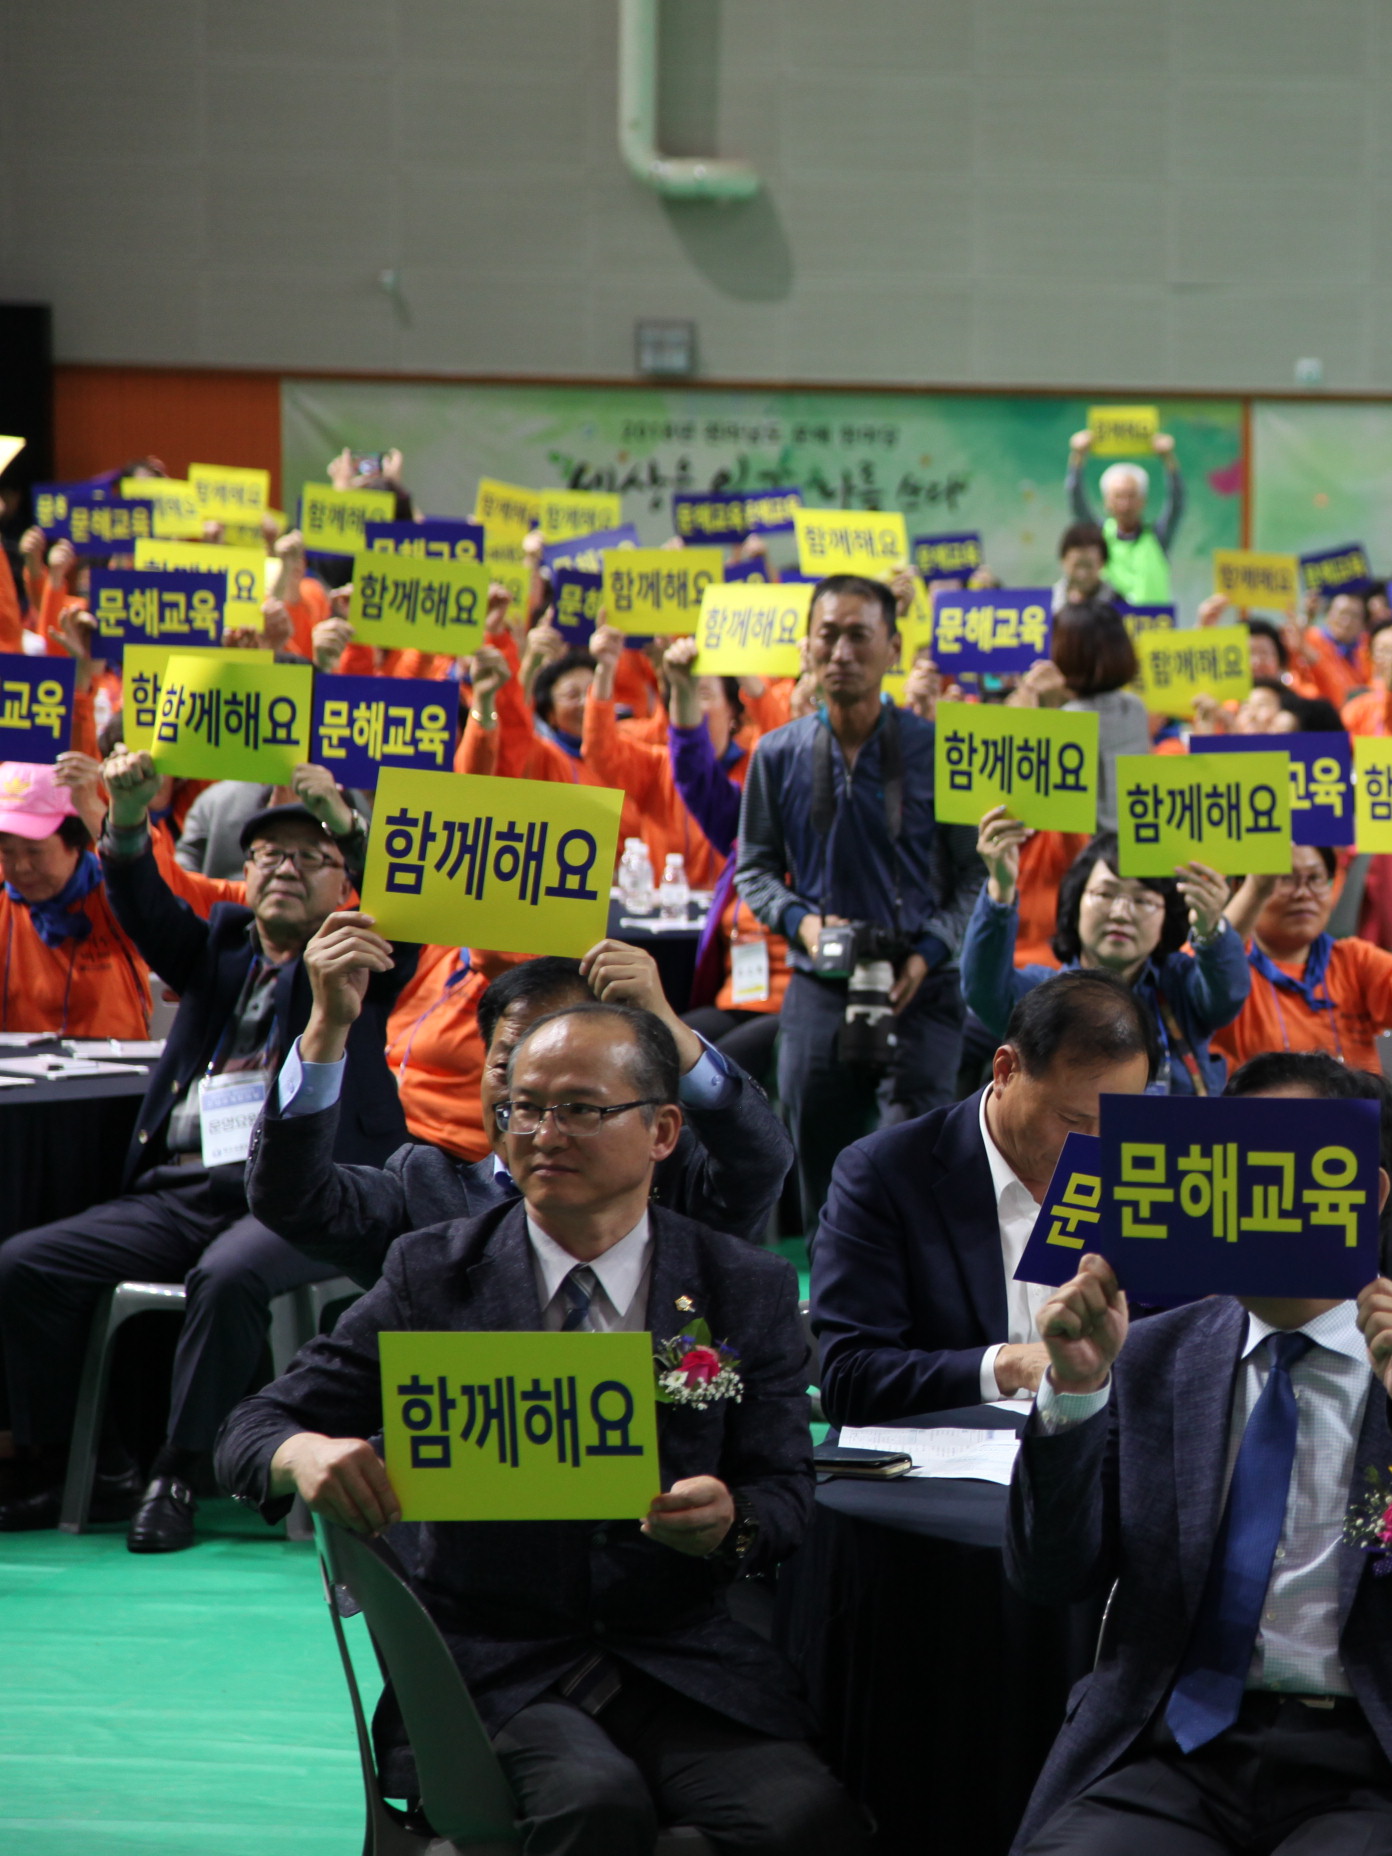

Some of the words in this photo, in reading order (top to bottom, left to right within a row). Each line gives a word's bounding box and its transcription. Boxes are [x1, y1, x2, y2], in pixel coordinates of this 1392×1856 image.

[95, 588, 220, 640] 문해교육
[361, 572, 479, 628] 함께해요
[706, 607, 799, 650] 함께해요
[936, 604, 1049, 654] 문해교육
[1151, 645, 1244, 688] 함께해요
[157, 684, 300, 750] 함께해요
[317, 701, 450, 765] 문해교육
[945, 730, 1088, 797] 함께해요
[1127, 782, 1282, 844] 함께해요
[384, 807, 599, 907] 함께해요
[1113, 1142, 1367, 1249] 문해교육
[397, 1374, 645, 1470] 함께해요
